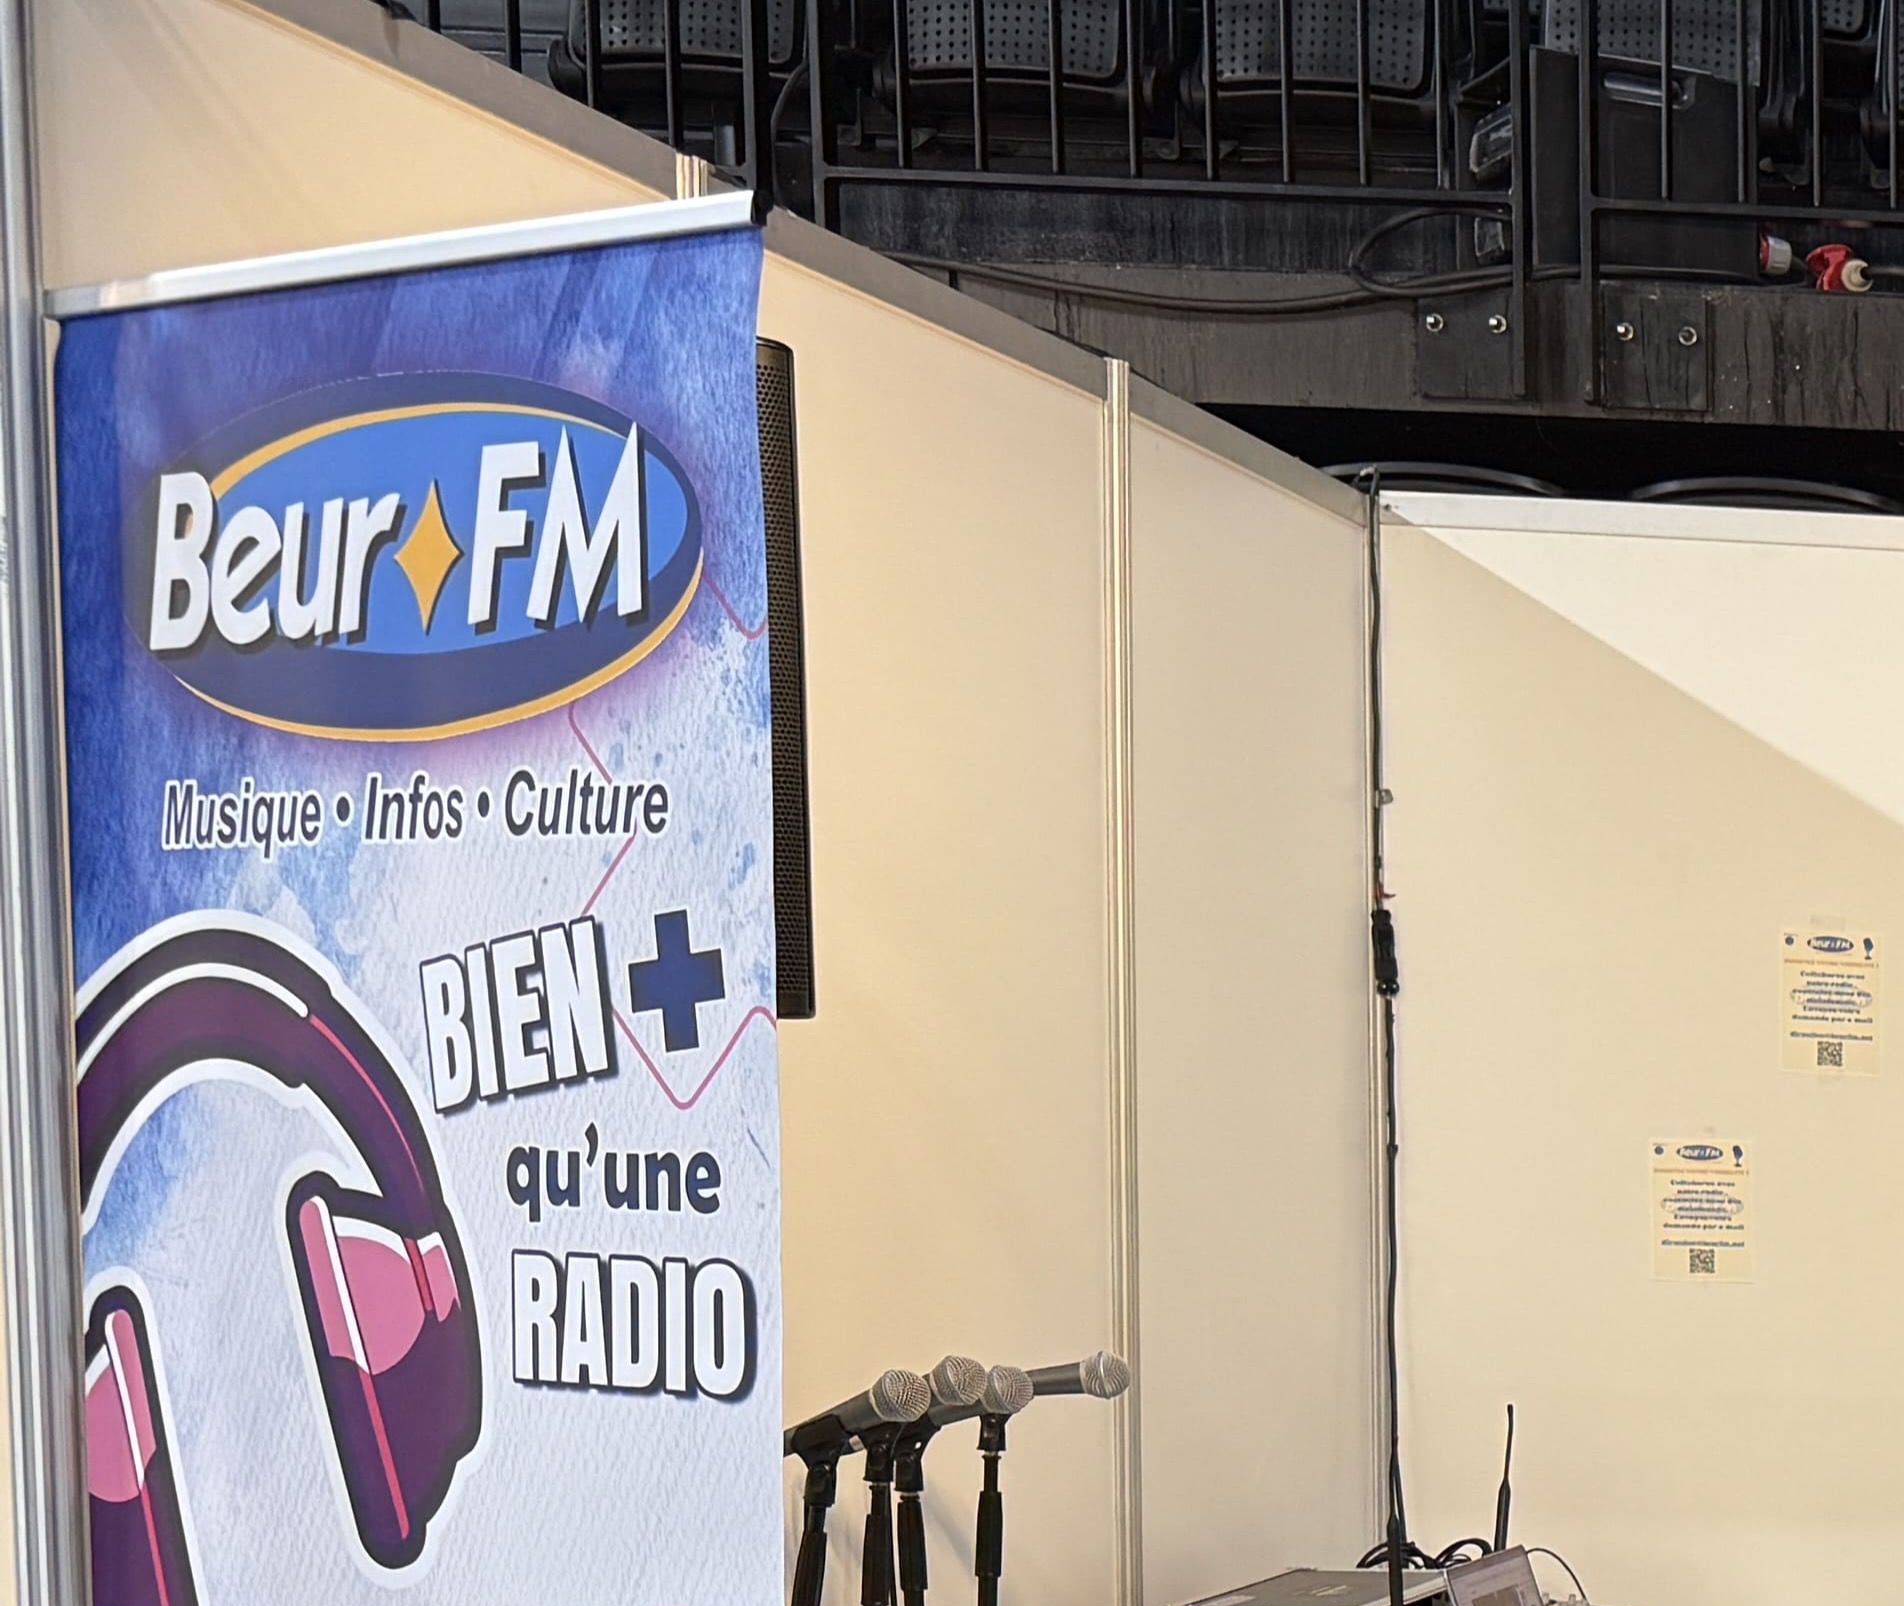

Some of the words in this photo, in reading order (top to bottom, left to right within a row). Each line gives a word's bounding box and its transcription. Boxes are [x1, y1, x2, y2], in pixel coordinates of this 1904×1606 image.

[149, 471, 401, 652] Beur
[467, 421, 645, 626] FM
[162, 778, 322, 859] Musique
[364, 773, 464, 842] Infos
[505, 768, 669, 838] Culture
[420, 915, 620, 1114] BIEN
[511, 1250, 757, 1400] RADIO
